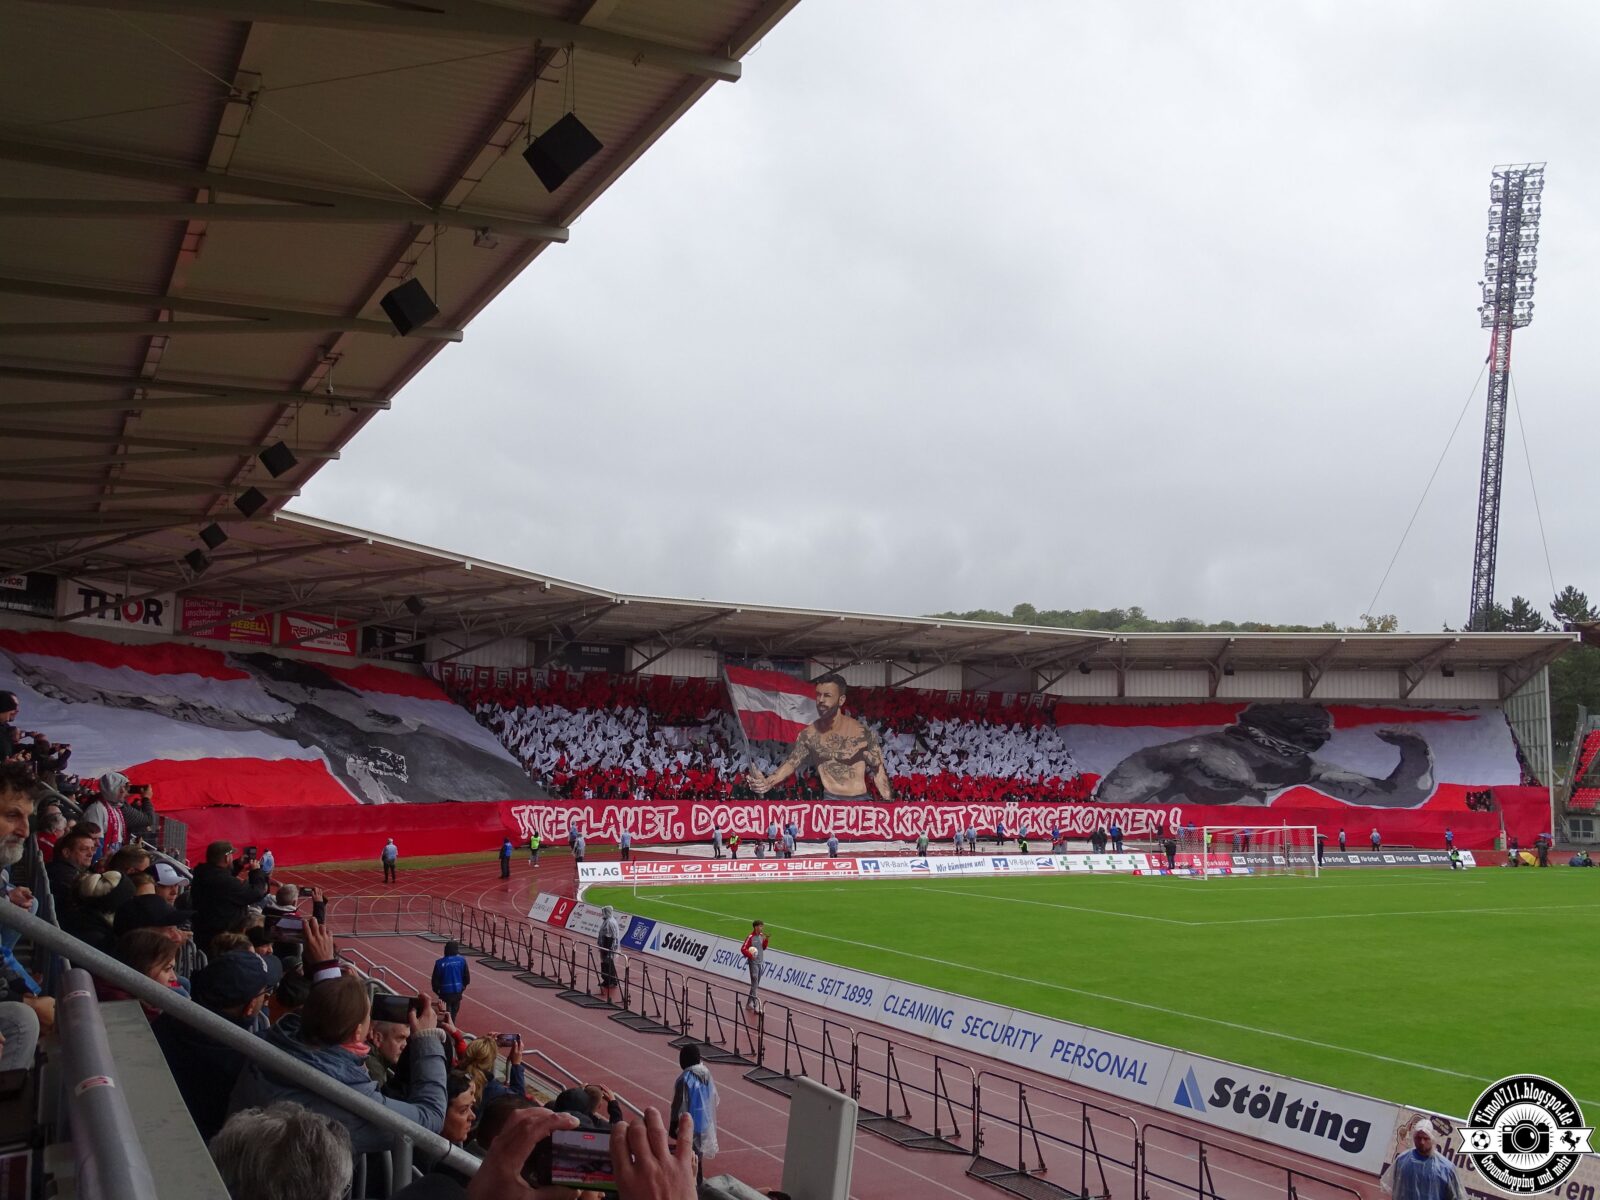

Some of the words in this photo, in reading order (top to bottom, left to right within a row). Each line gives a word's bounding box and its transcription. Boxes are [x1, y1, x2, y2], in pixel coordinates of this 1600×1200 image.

[78, 588, 163, 626] THOR
[691, 804, 764, 836] DOCH
[768, 804, 810, 839] MIT
[812, 804, 892, 837] NEUER
[893, 805, 966, 837] KRAFT
[628, 863, 676, 874] saller
[710, 860, 755, 872] saller
[787, 859, 828, 871] saller
[661, 931, 709, 961] Stölting
[712, 949, 750, 973] SERVICE
[774, 966, 784, 980] A
[782, 967, 816, 991] SMILE.
[817, 977, 845, 997] SEIT
[841, 983, 873, 1007] 1899.
[883, 995, 955, 1030] CLEANING
[961, 1015, 1043, 1053] SECURITY
[1050, 1039, 1149, 1086] PERSONAL
[1207, 1077, 1372, 1154] Stölting
